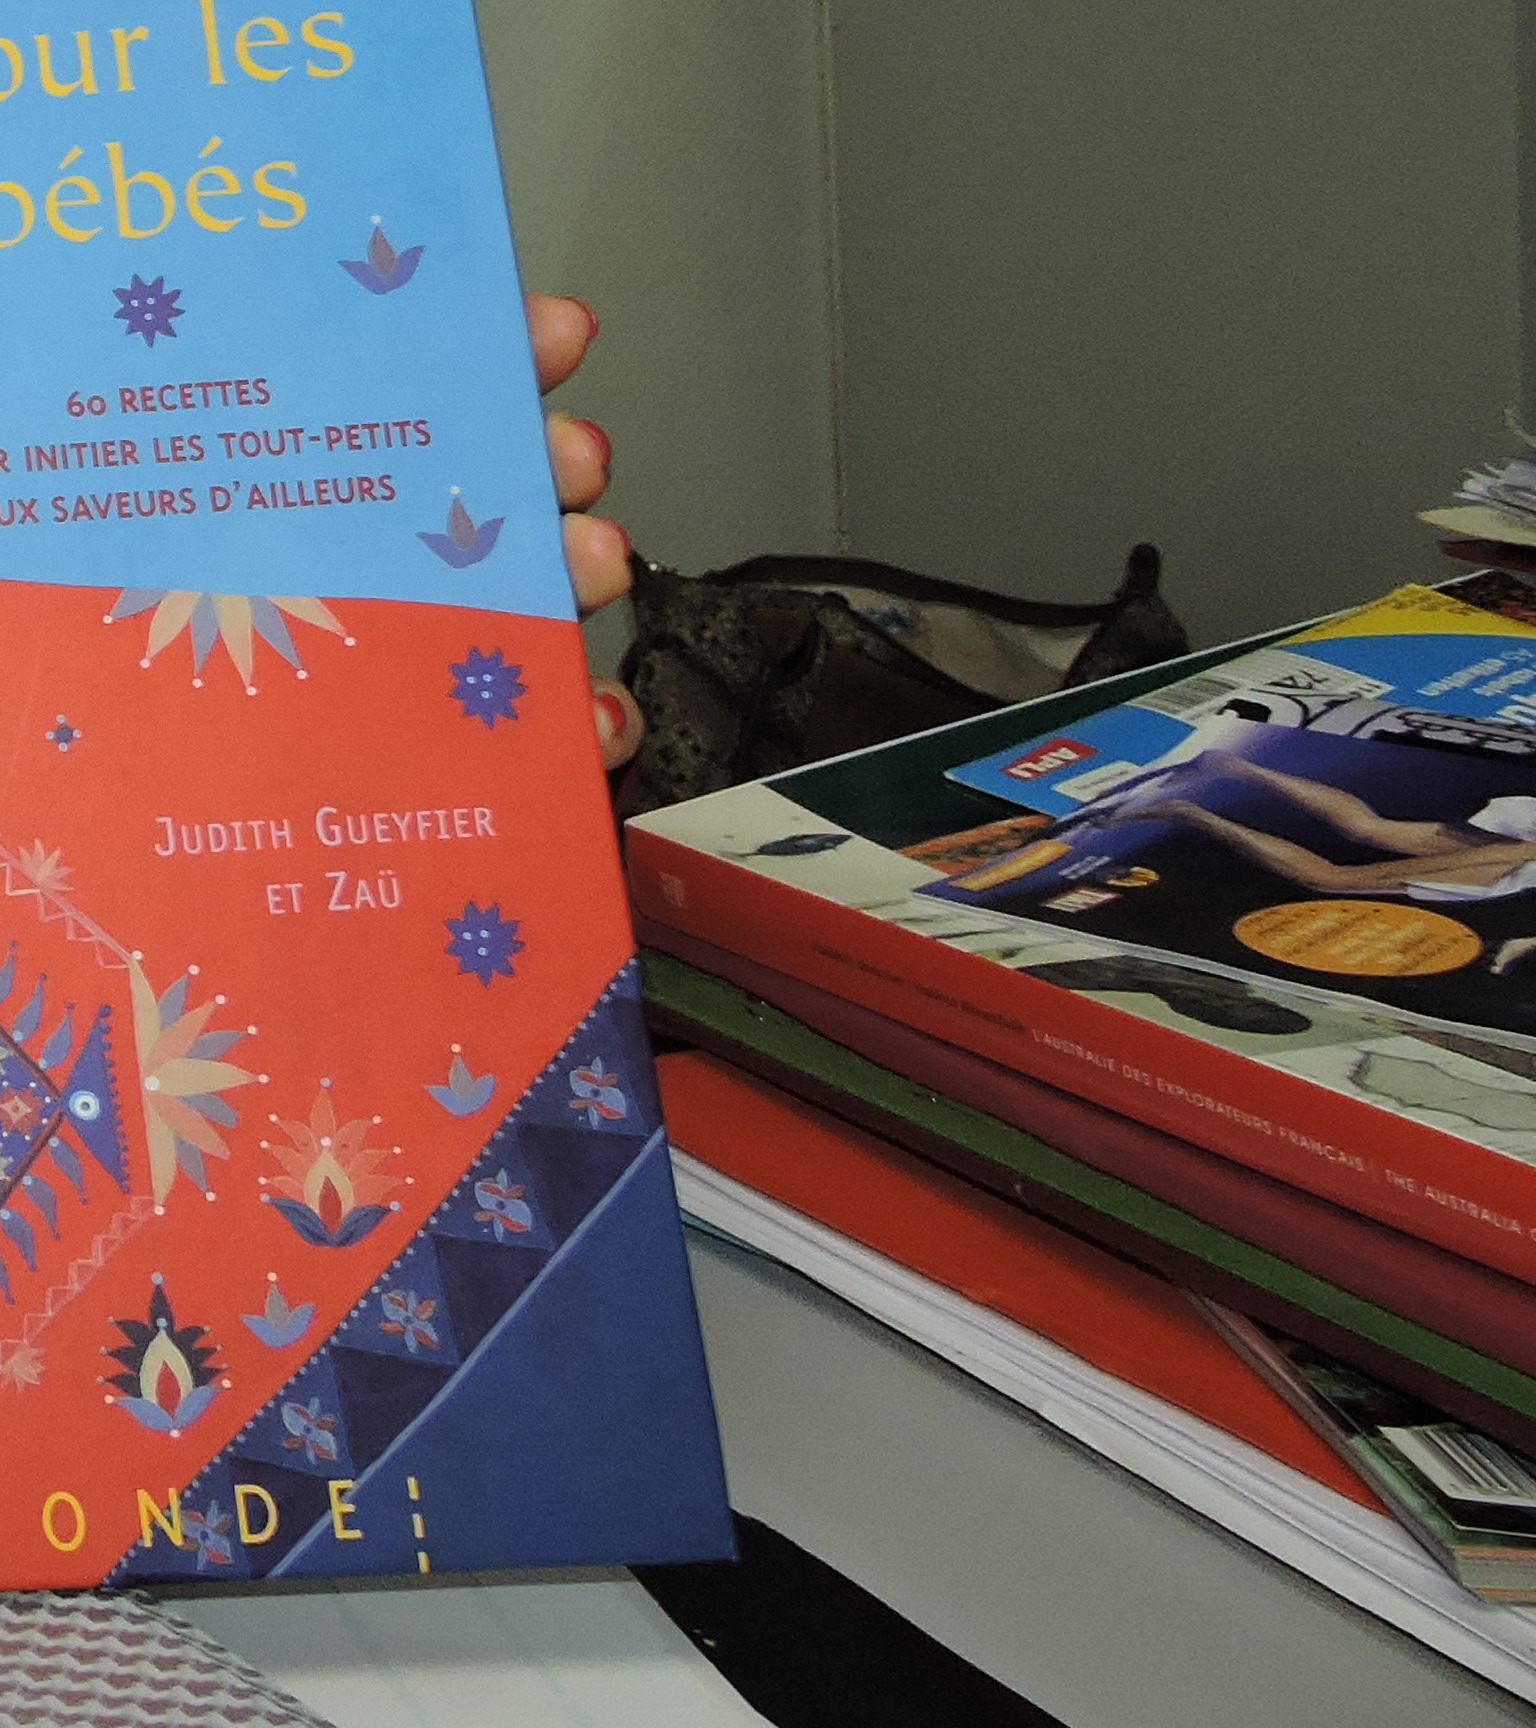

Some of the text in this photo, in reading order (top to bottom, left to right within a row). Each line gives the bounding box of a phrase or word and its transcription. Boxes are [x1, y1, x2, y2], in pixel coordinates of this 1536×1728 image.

[66, 376, 274, 420] 60 RECETTES
[24, 438, 142, 474] INITIER
[152, 433, 208, 466] LES
[218, 418, 434, 459] TOUT-PETITS
[50, 486, 199, 525] SAVEURS
[208, 473, 399, 514] D'AILLEURS
[1008, 746, 1080, 779] APLI
[1122, 1064, 1152, 1087] DES
[1156, 1078, 1273, 1135] EXPLORATEURS
[1385, 1168, 1415, 1193] THE
[1424, 1185, 1521, 1235] AUSTRALIA
